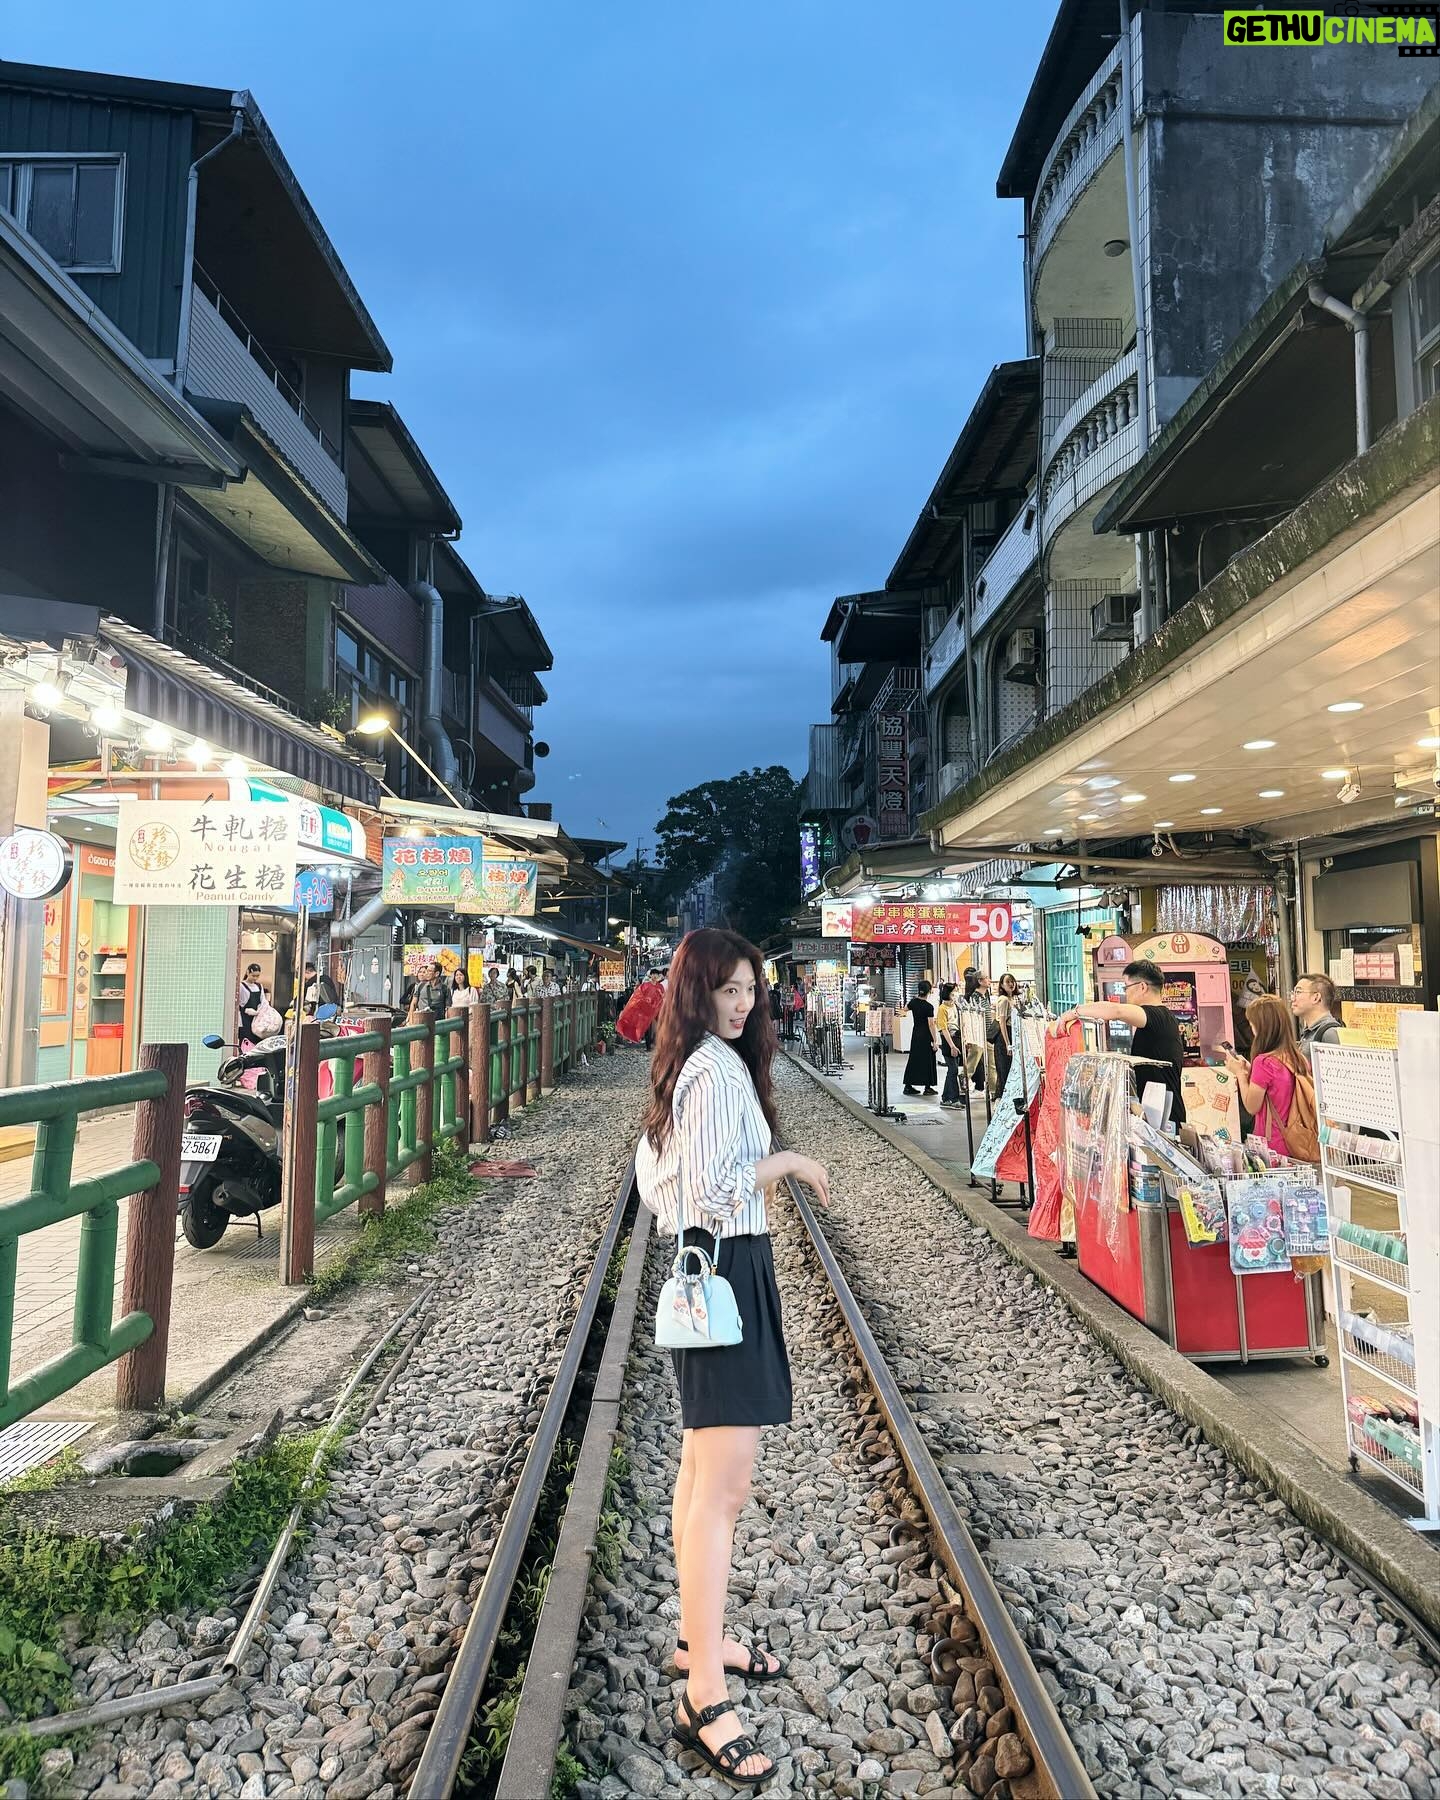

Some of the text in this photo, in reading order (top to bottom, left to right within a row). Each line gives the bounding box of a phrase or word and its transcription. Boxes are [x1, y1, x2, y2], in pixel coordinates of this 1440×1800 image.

[880, 714, 904, 811] 協豐天燈
[190, 814, 289, 842] 牛軋糖
[392, 847, 473, 865] 花枝燒
[187, 863, 287, 892] 花生糖
[196, 892, 275, 903] Peanut Candy
[969, 907, 1010, 940] 50
[181, 1141, 217, 1155] Z-5861
